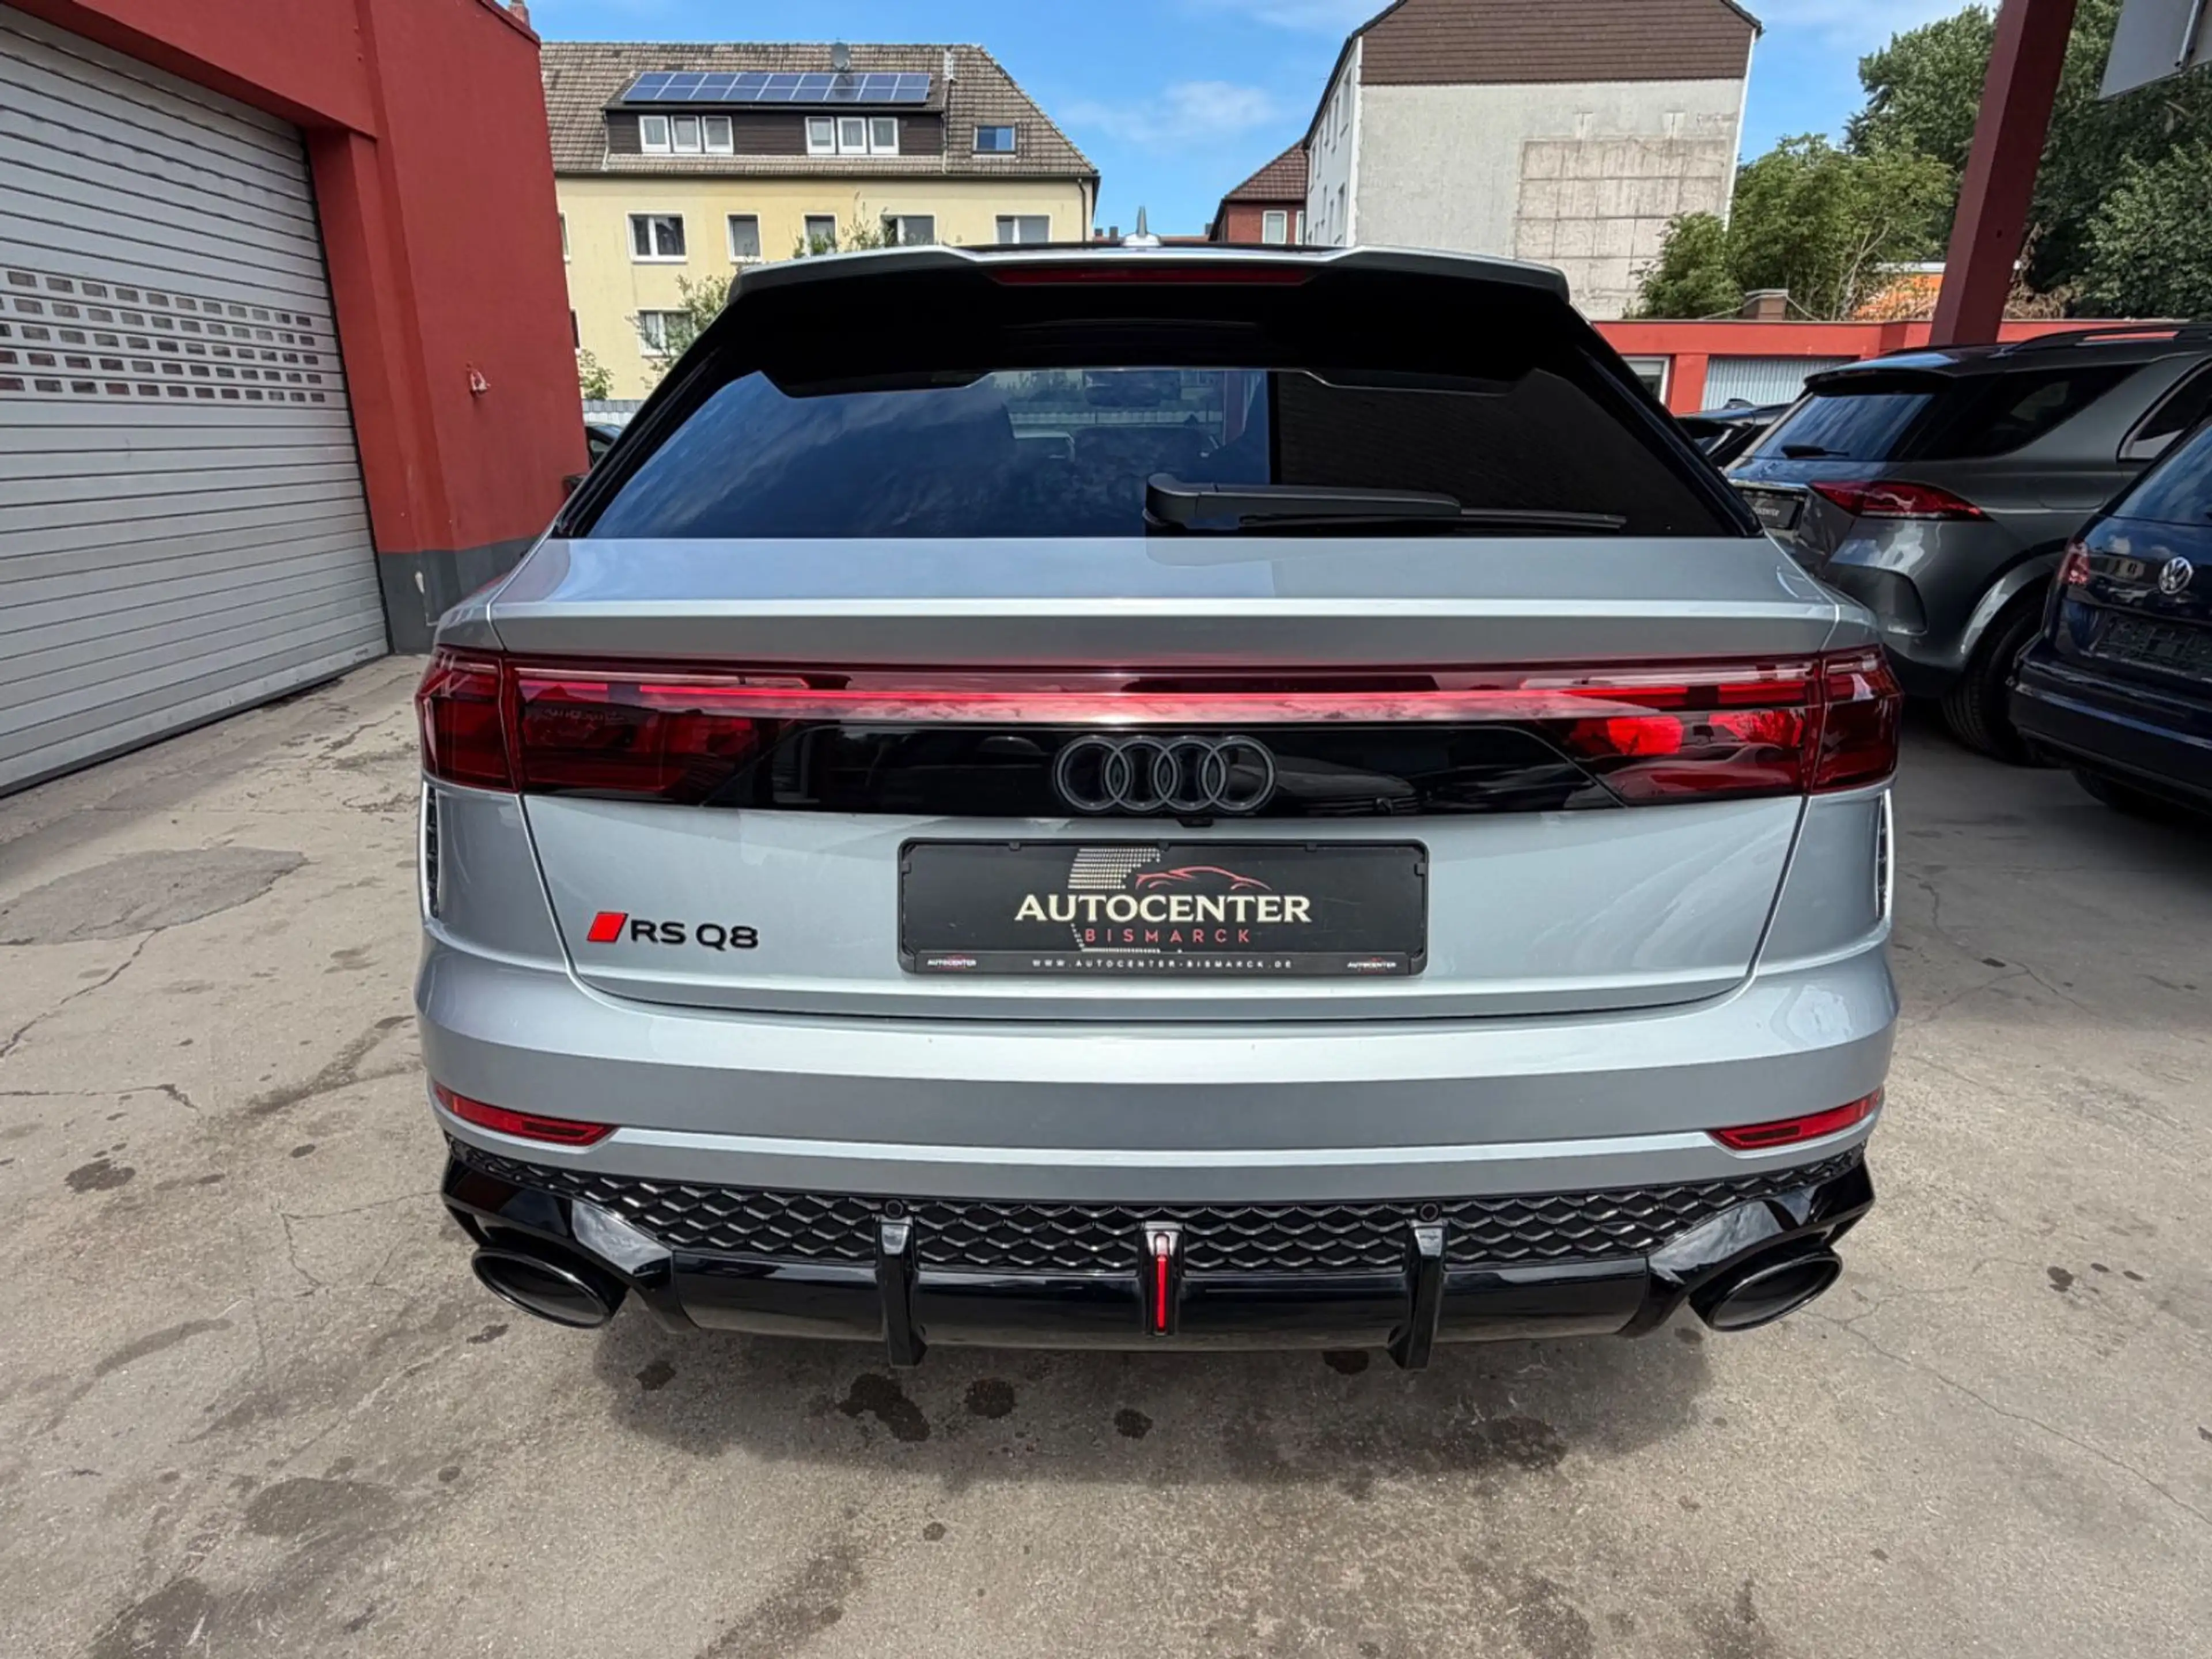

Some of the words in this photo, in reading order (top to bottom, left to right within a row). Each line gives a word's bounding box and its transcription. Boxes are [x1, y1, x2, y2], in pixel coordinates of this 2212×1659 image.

[1014, 894, 1312, 922] AUTOCENTER
[630, 919, 687, 945] RS
[696, 923, 758, 952] Q8
[1085, 928, 1250, 943] BISMARCK
